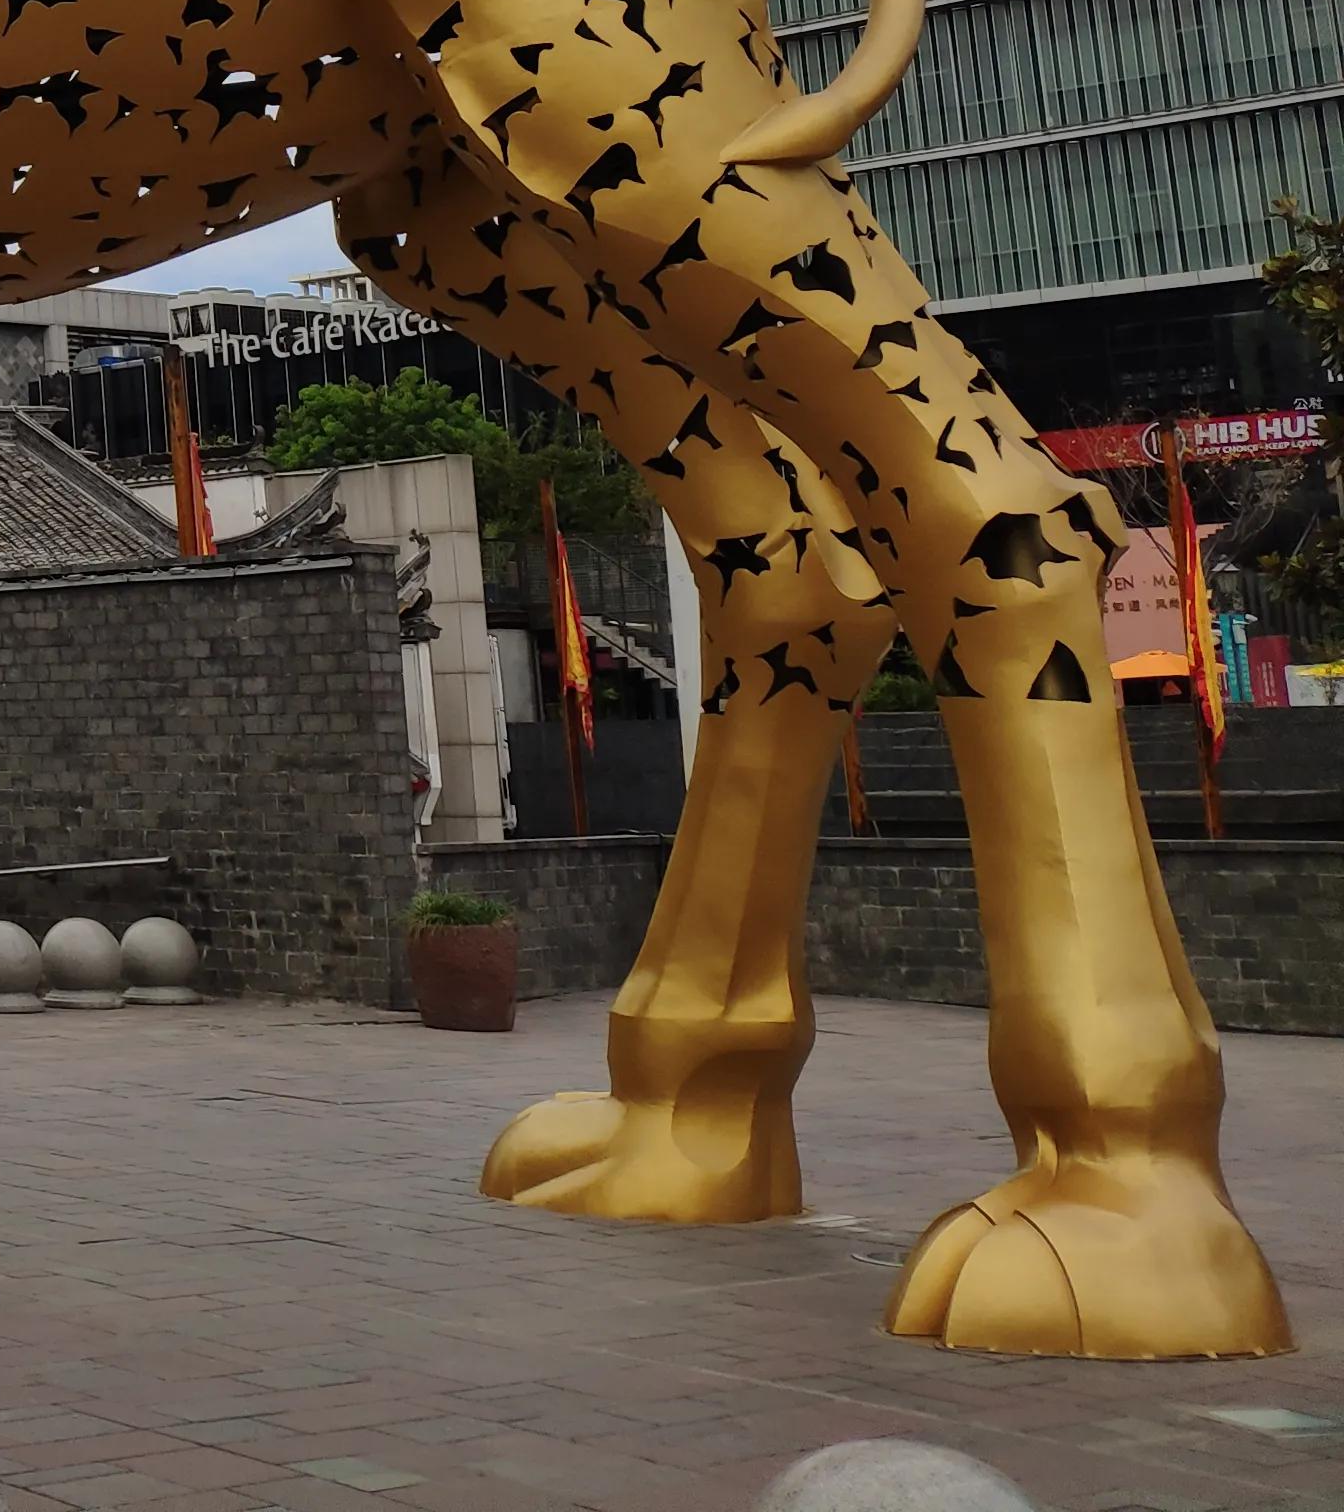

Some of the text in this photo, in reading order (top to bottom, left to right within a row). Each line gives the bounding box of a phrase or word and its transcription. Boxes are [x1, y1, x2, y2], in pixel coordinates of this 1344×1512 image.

[200, 306, 454, 369] The Cafe Kaca
